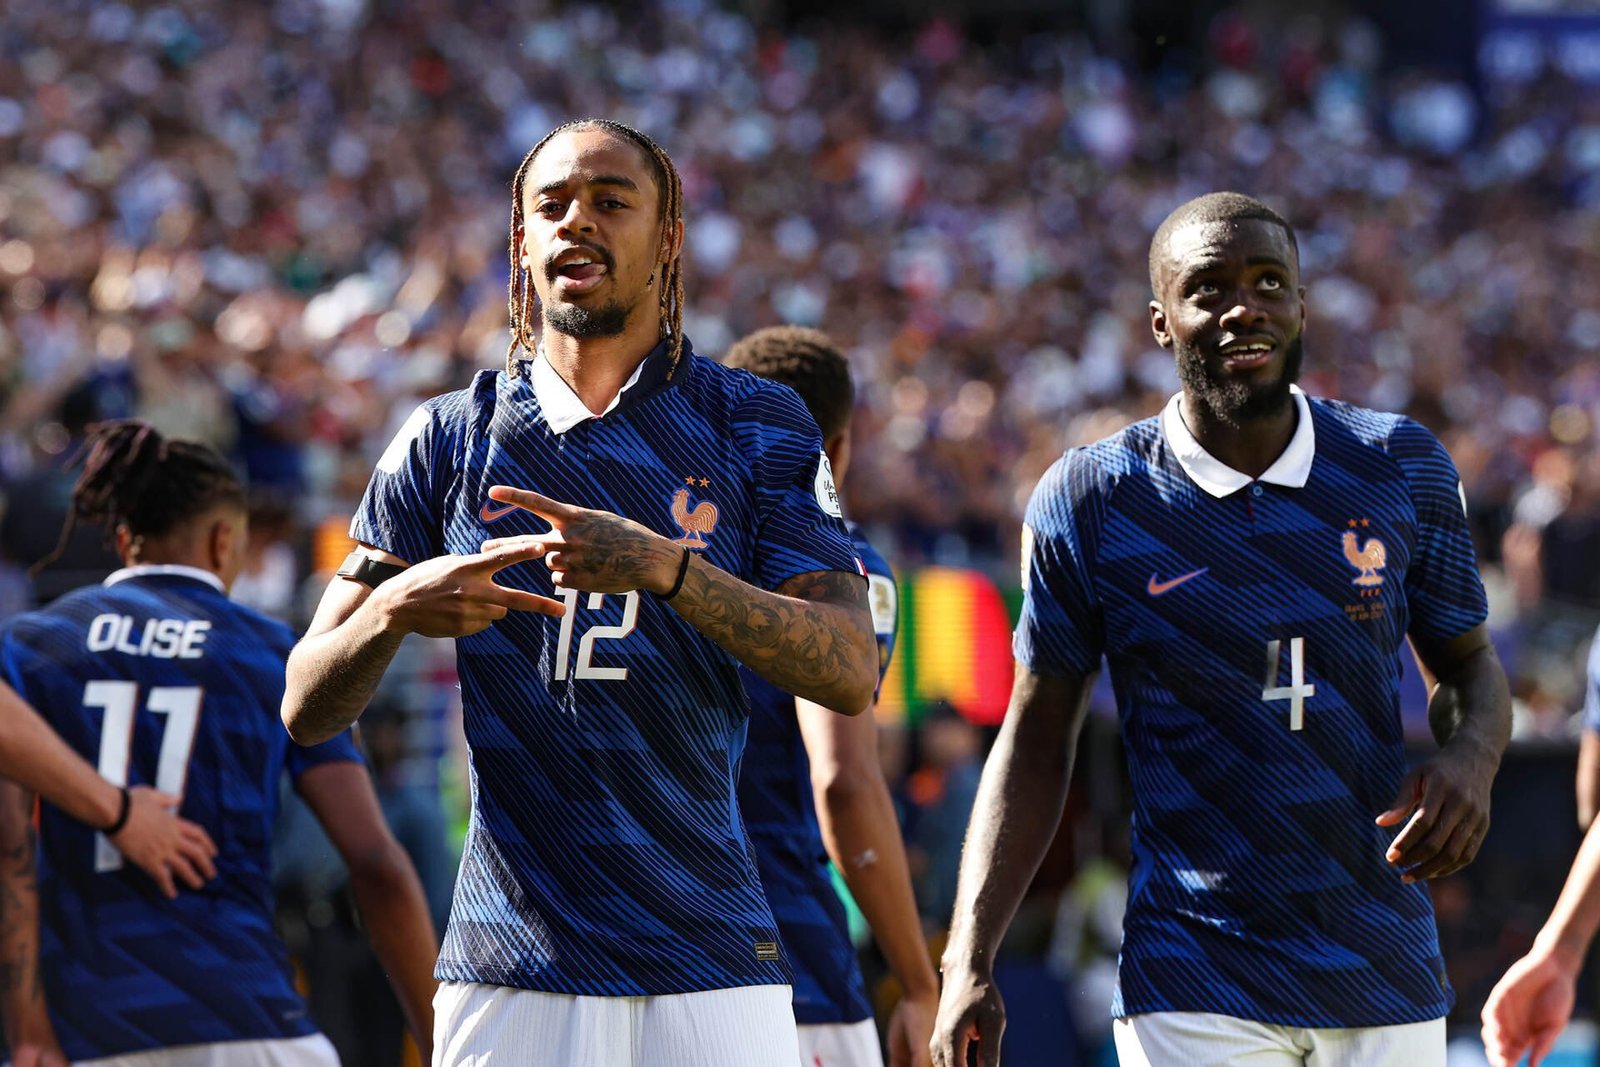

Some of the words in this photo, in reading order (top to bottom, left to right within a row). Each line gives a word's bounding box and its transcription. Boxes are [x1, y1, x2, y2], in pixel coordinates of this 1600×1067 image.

[86, 613, 212, 659] OLISE
[554, 586, 639, 681] 12
[1262, 637, 1314, 730] 4
[83, 680, 204, 873] 11
